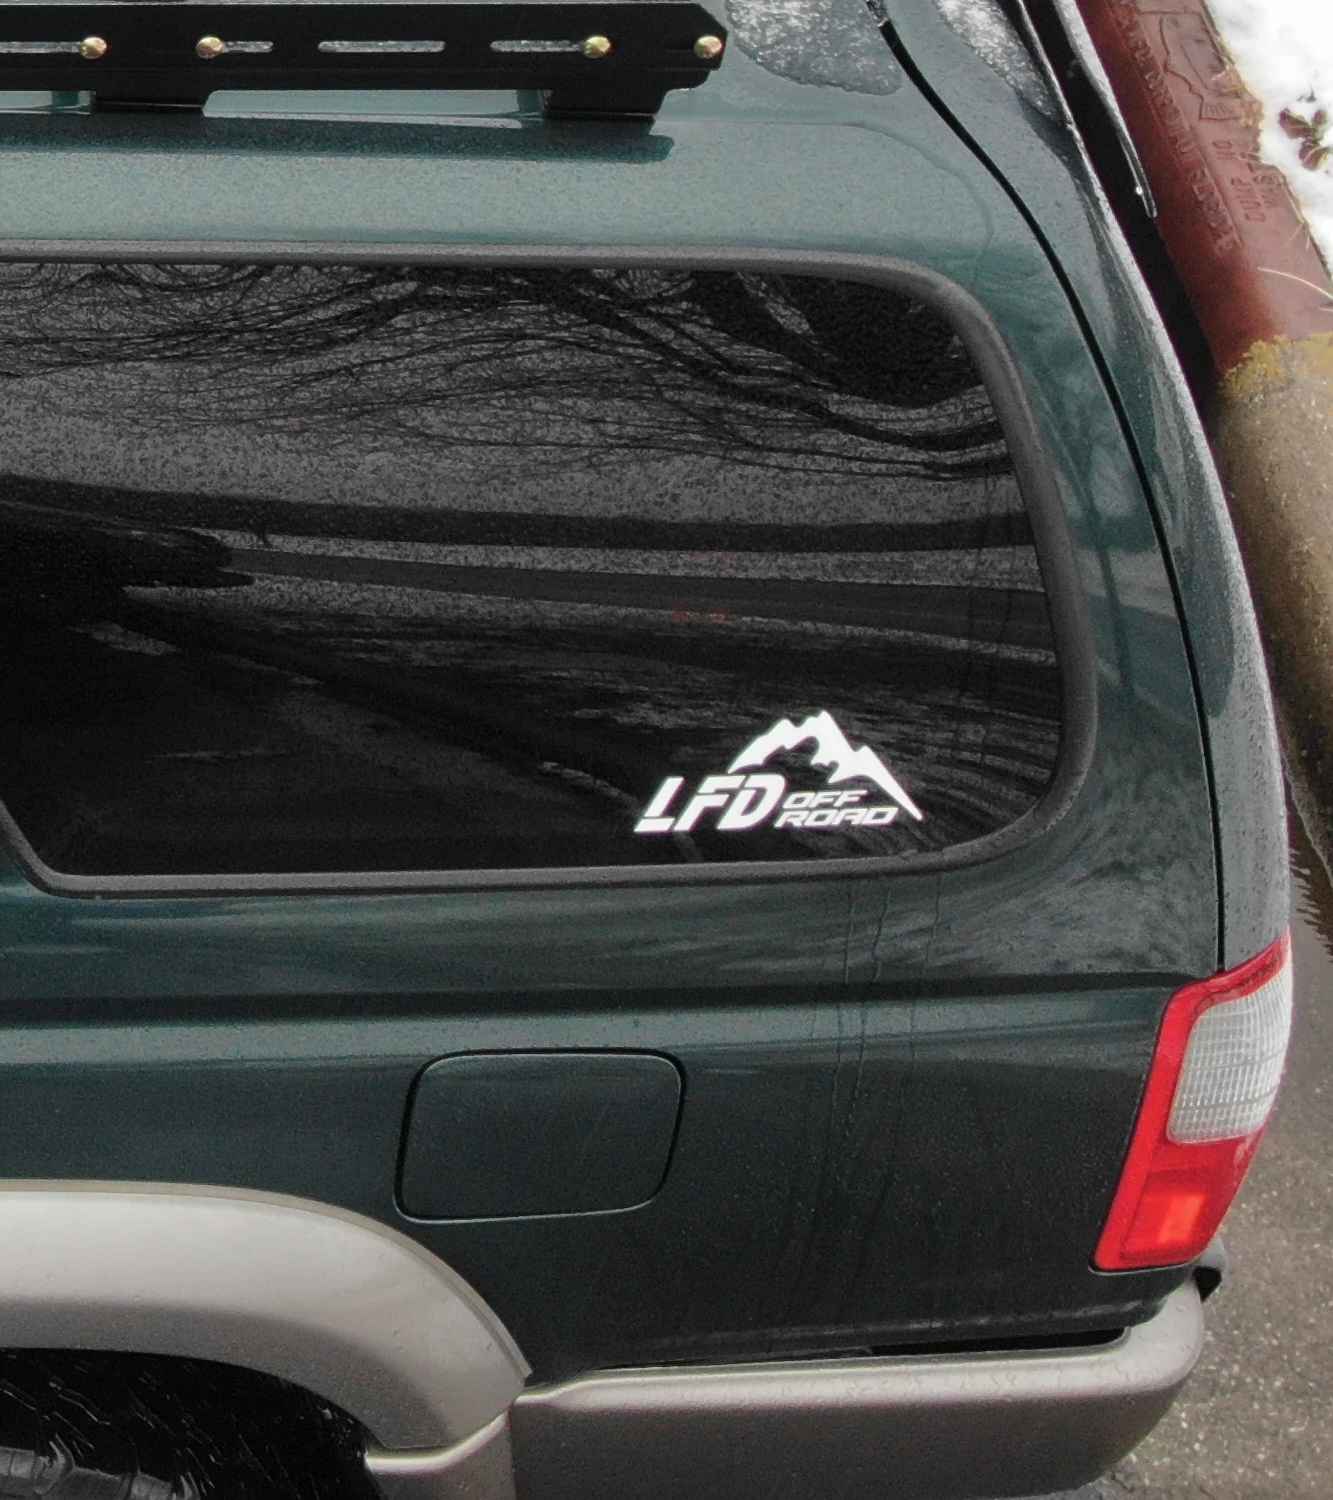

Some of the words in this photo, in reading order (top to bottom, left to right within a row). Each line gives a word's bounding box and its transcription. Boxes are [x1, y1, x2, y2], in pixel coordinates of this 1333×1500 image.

[634, 774, 787, 833] LFD
[782, 789, 868, 809] OFF
[774, 807, 899, 829] ROAD
